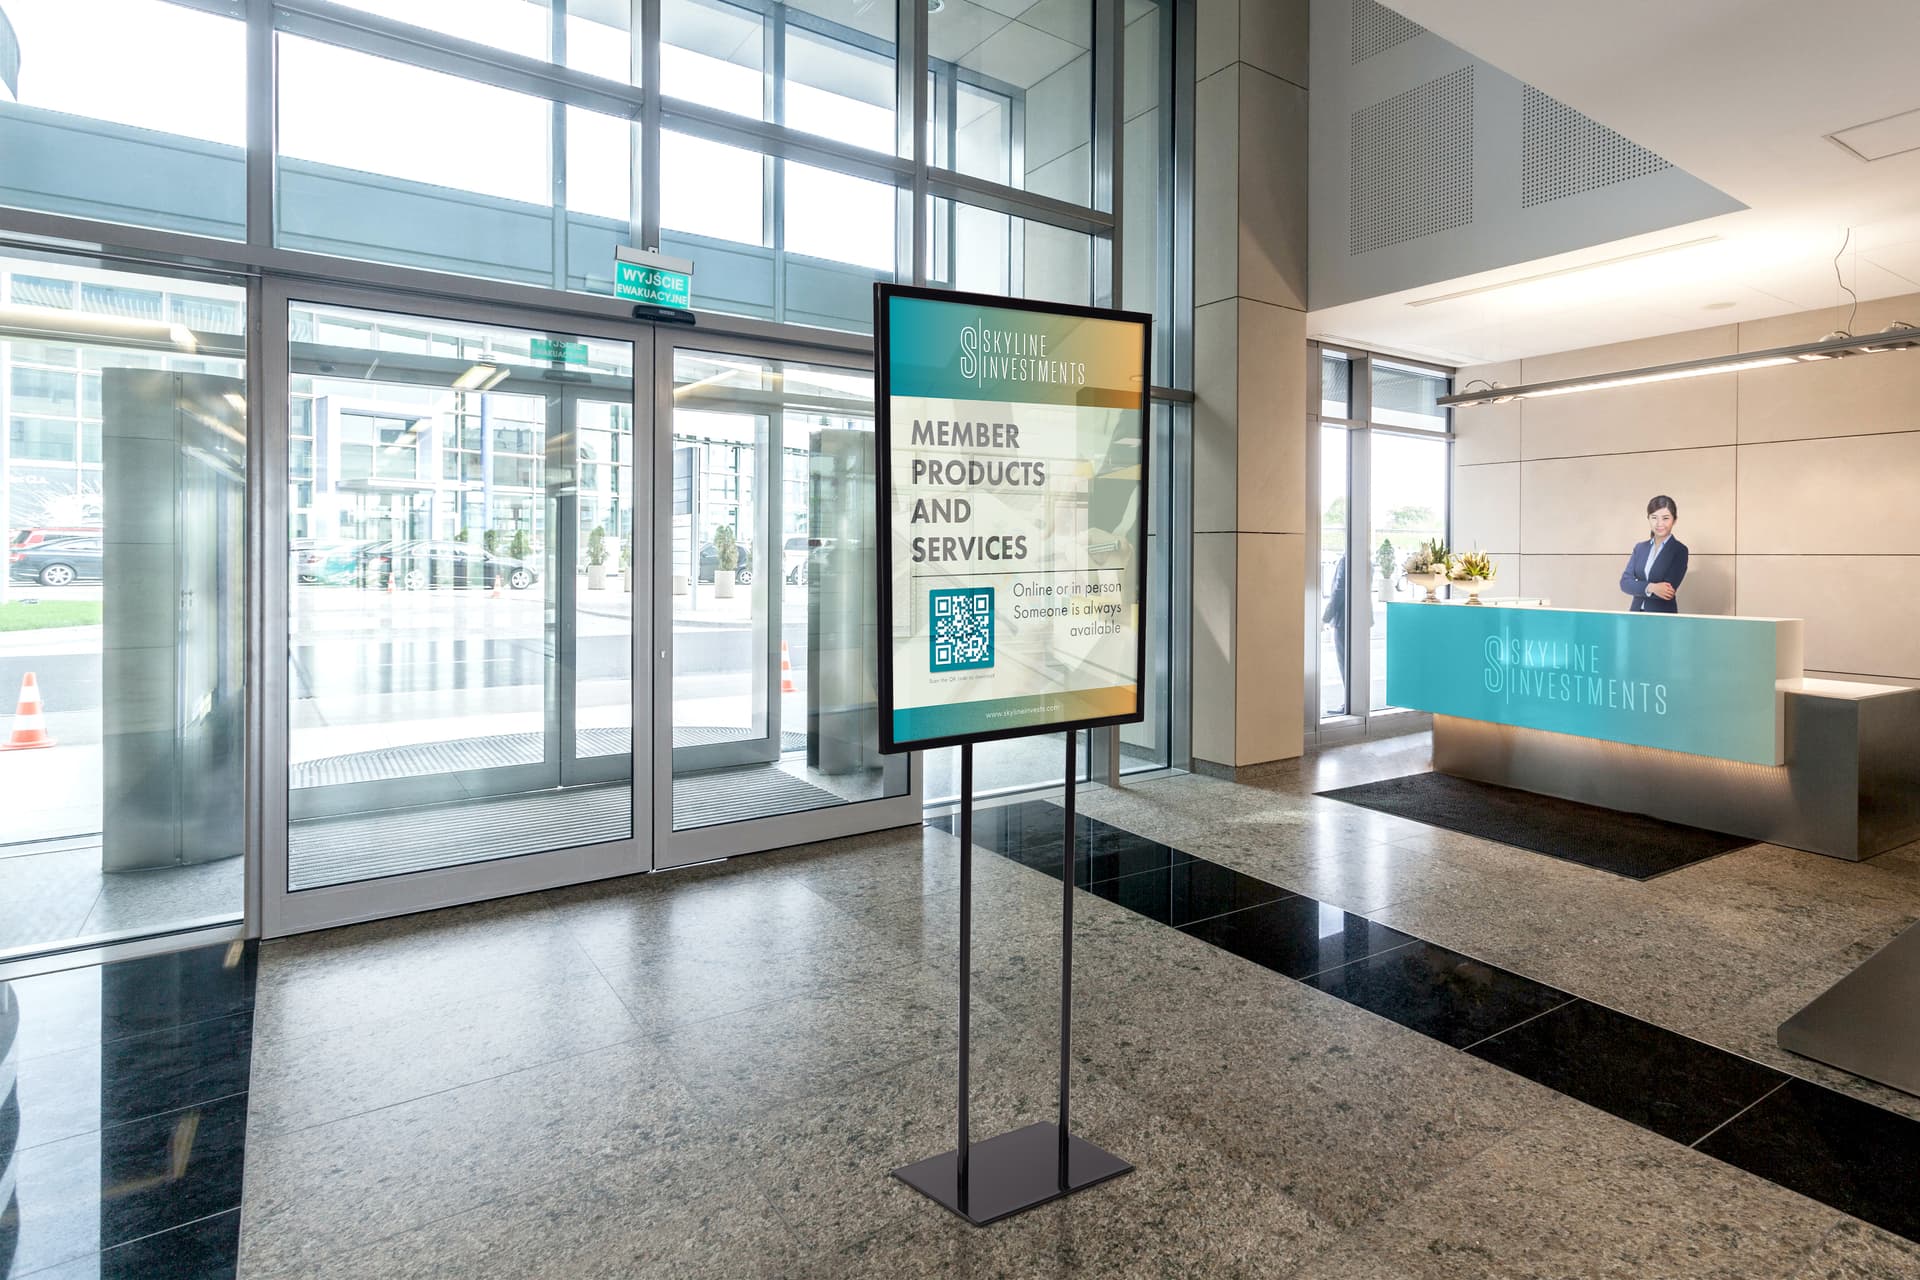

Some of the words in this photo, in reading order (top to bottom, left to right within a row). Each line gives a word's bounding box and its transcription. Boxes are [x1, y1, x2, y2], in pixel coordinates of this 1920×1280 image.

[623, 267, 684, 291] WYJŚCIE
[617, 283, 688, 305] EWAKUACYJNE
[983, 329, 1047, 358] SKYLINE
[983, 357, 1085, 385] INVESTMENTS
[911, 419, 1020, 449] MEMBER
[911, 459, 1046, 486] PRODUCTS
[910, 498, 971, 524] AND
[911, 535, 1028, 563] SERVICES
[1013, 581, 1053, 597] Online
[1056, 585, 1068, 595] or
[1071, 582, 1081, 594] in
[1085, 583, 1122, 598] person
[1013, 604, 1068, 619] Someone
[1071, 603, 1080, 616] is
[1083, 600, 1122, 617] always
[1070, 620, 1121, 637] available
[1511, 638, 1600, 674] SKYLINE
[1511, 667, 1667, 715] INVESTMENTS
